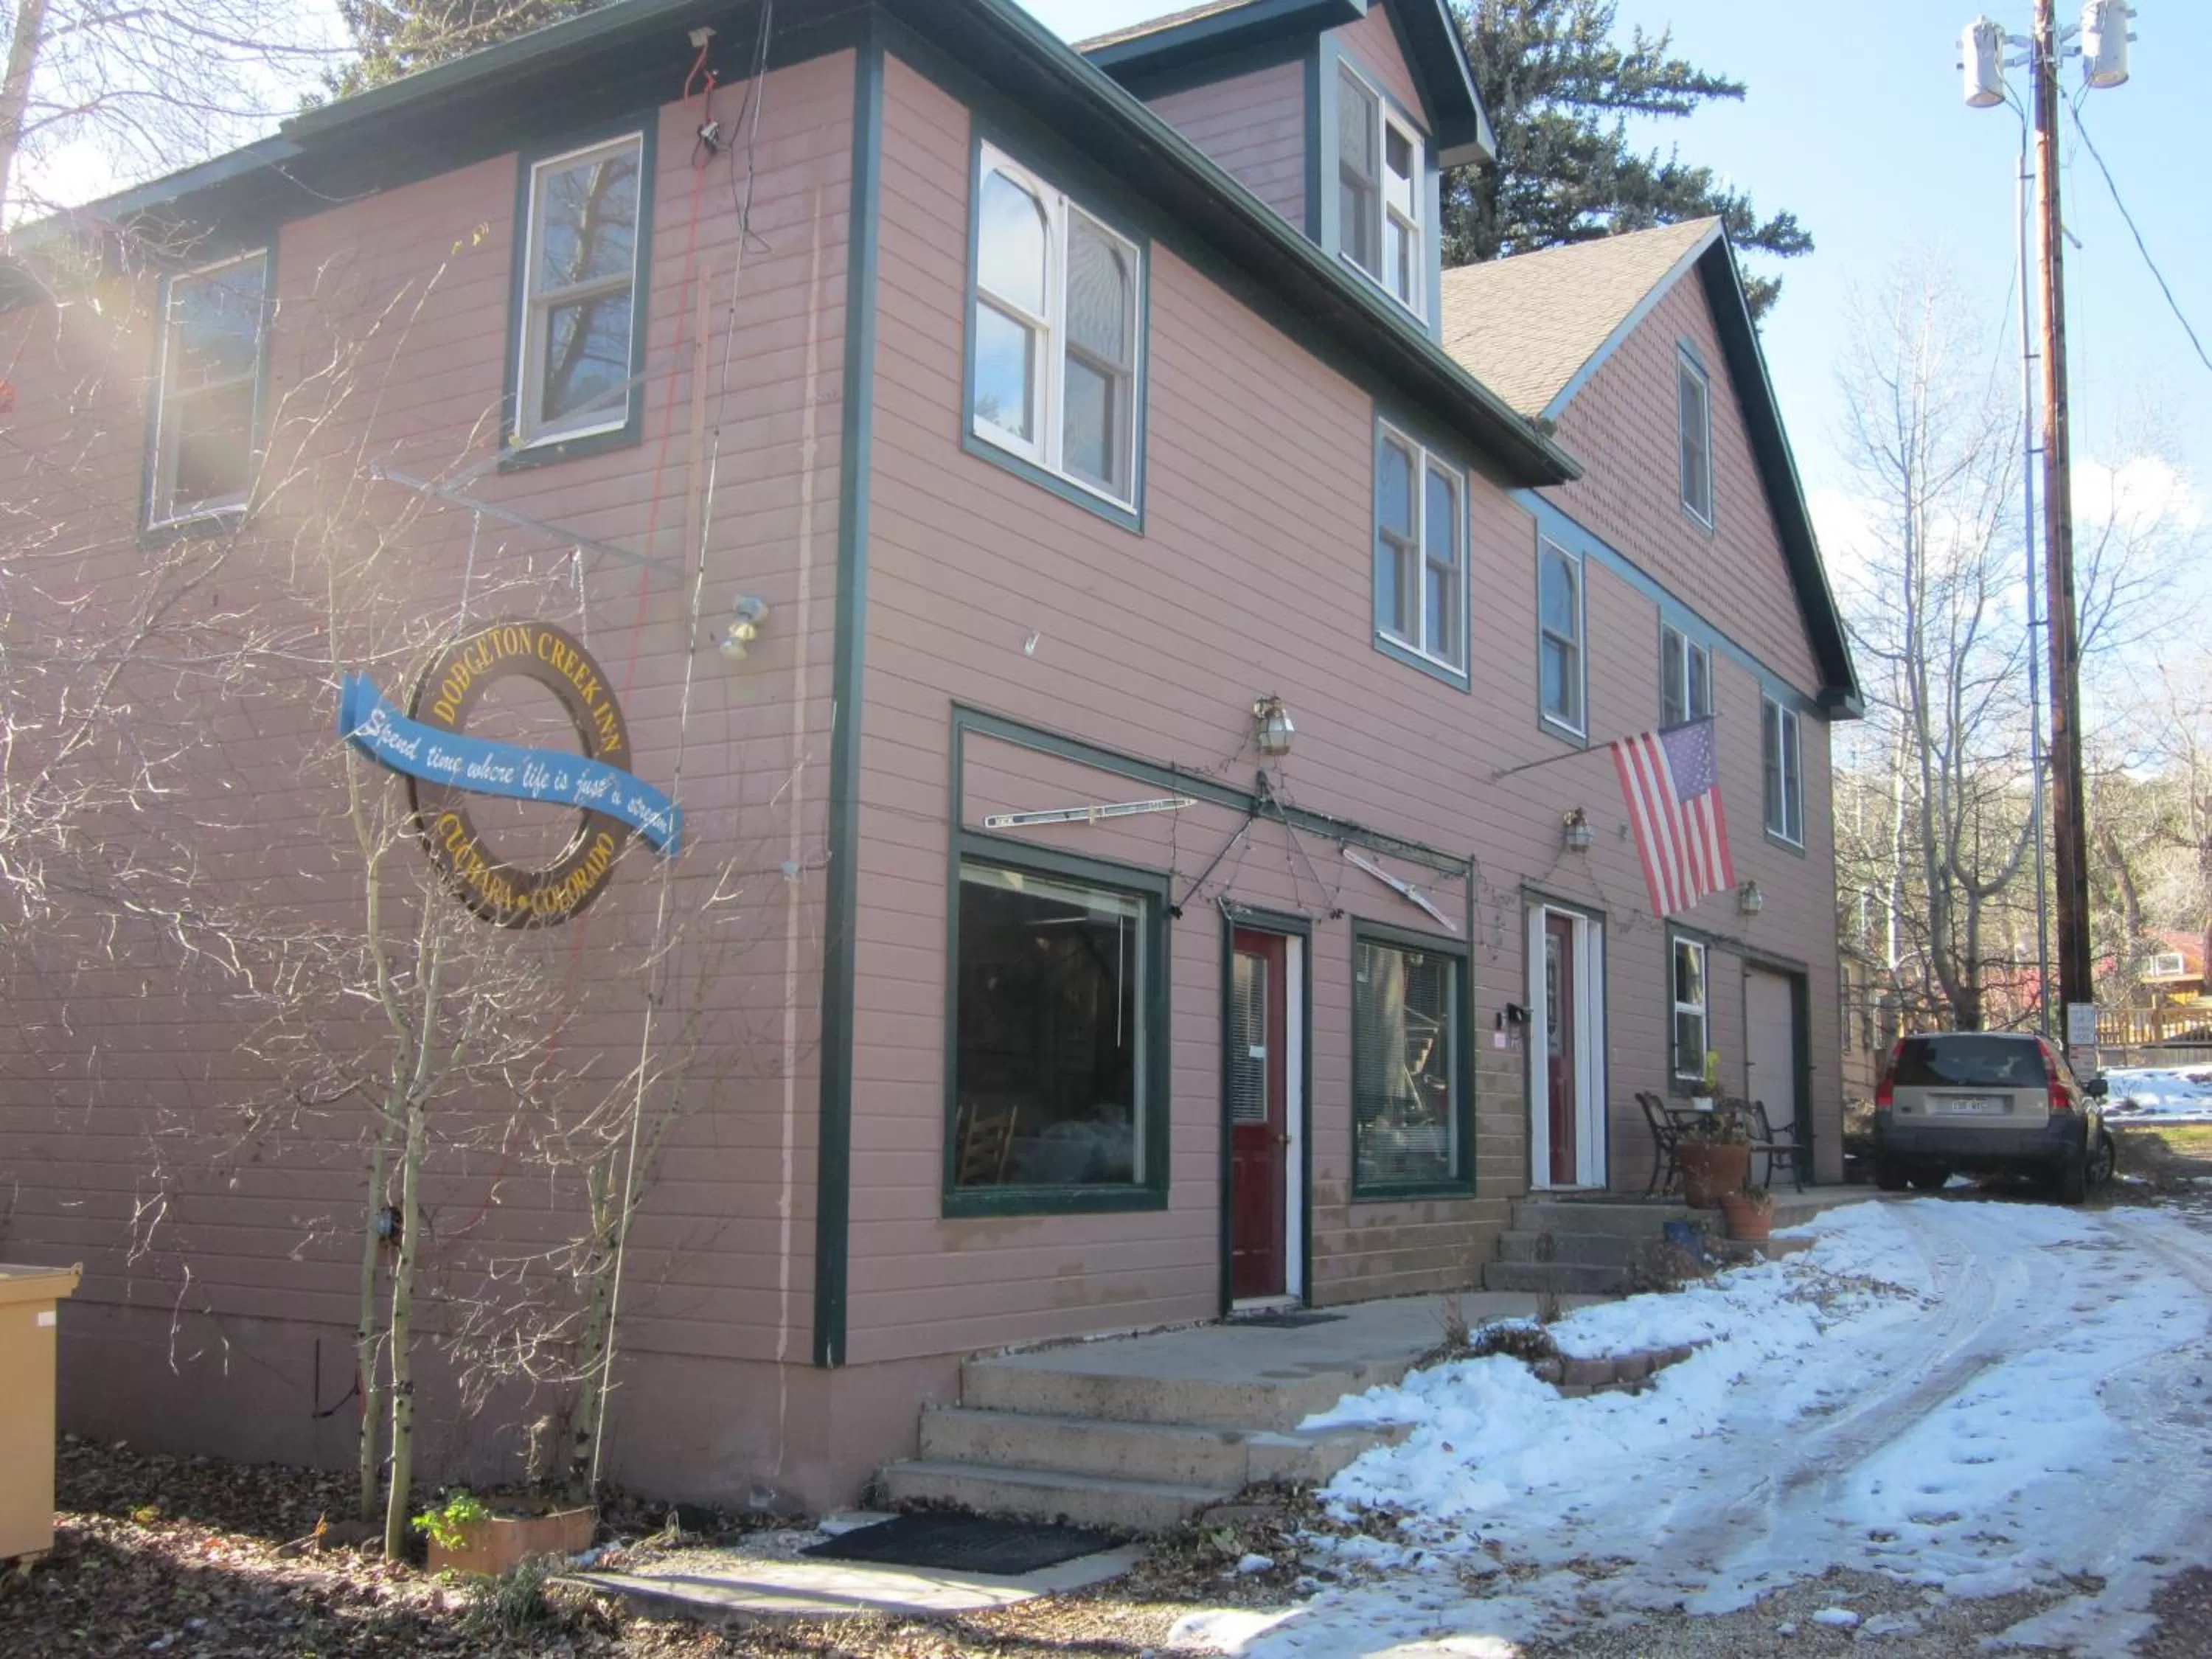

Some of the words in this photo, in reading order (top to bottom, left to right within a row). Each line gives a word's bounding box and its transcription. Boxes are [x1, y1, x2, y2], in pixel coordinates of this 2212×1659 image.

[432, 627, 532, 726] DODGETON
[538, 632, 602, 704] CREEK
[593, 701, 622, 752] INN
[355, 708, 422, 761] Spend
[426, 745, 462, 773] time
[467, 752, 515, 784] where
[522, 762, 551, 799] life
[554, 769, 568, 791] is
[573, 770, 615, 804] just
[611, 790, 622, 806] a
[439, 813, 512, 912] CUCHARA
[532, 832, 615, 916] COLORADO
